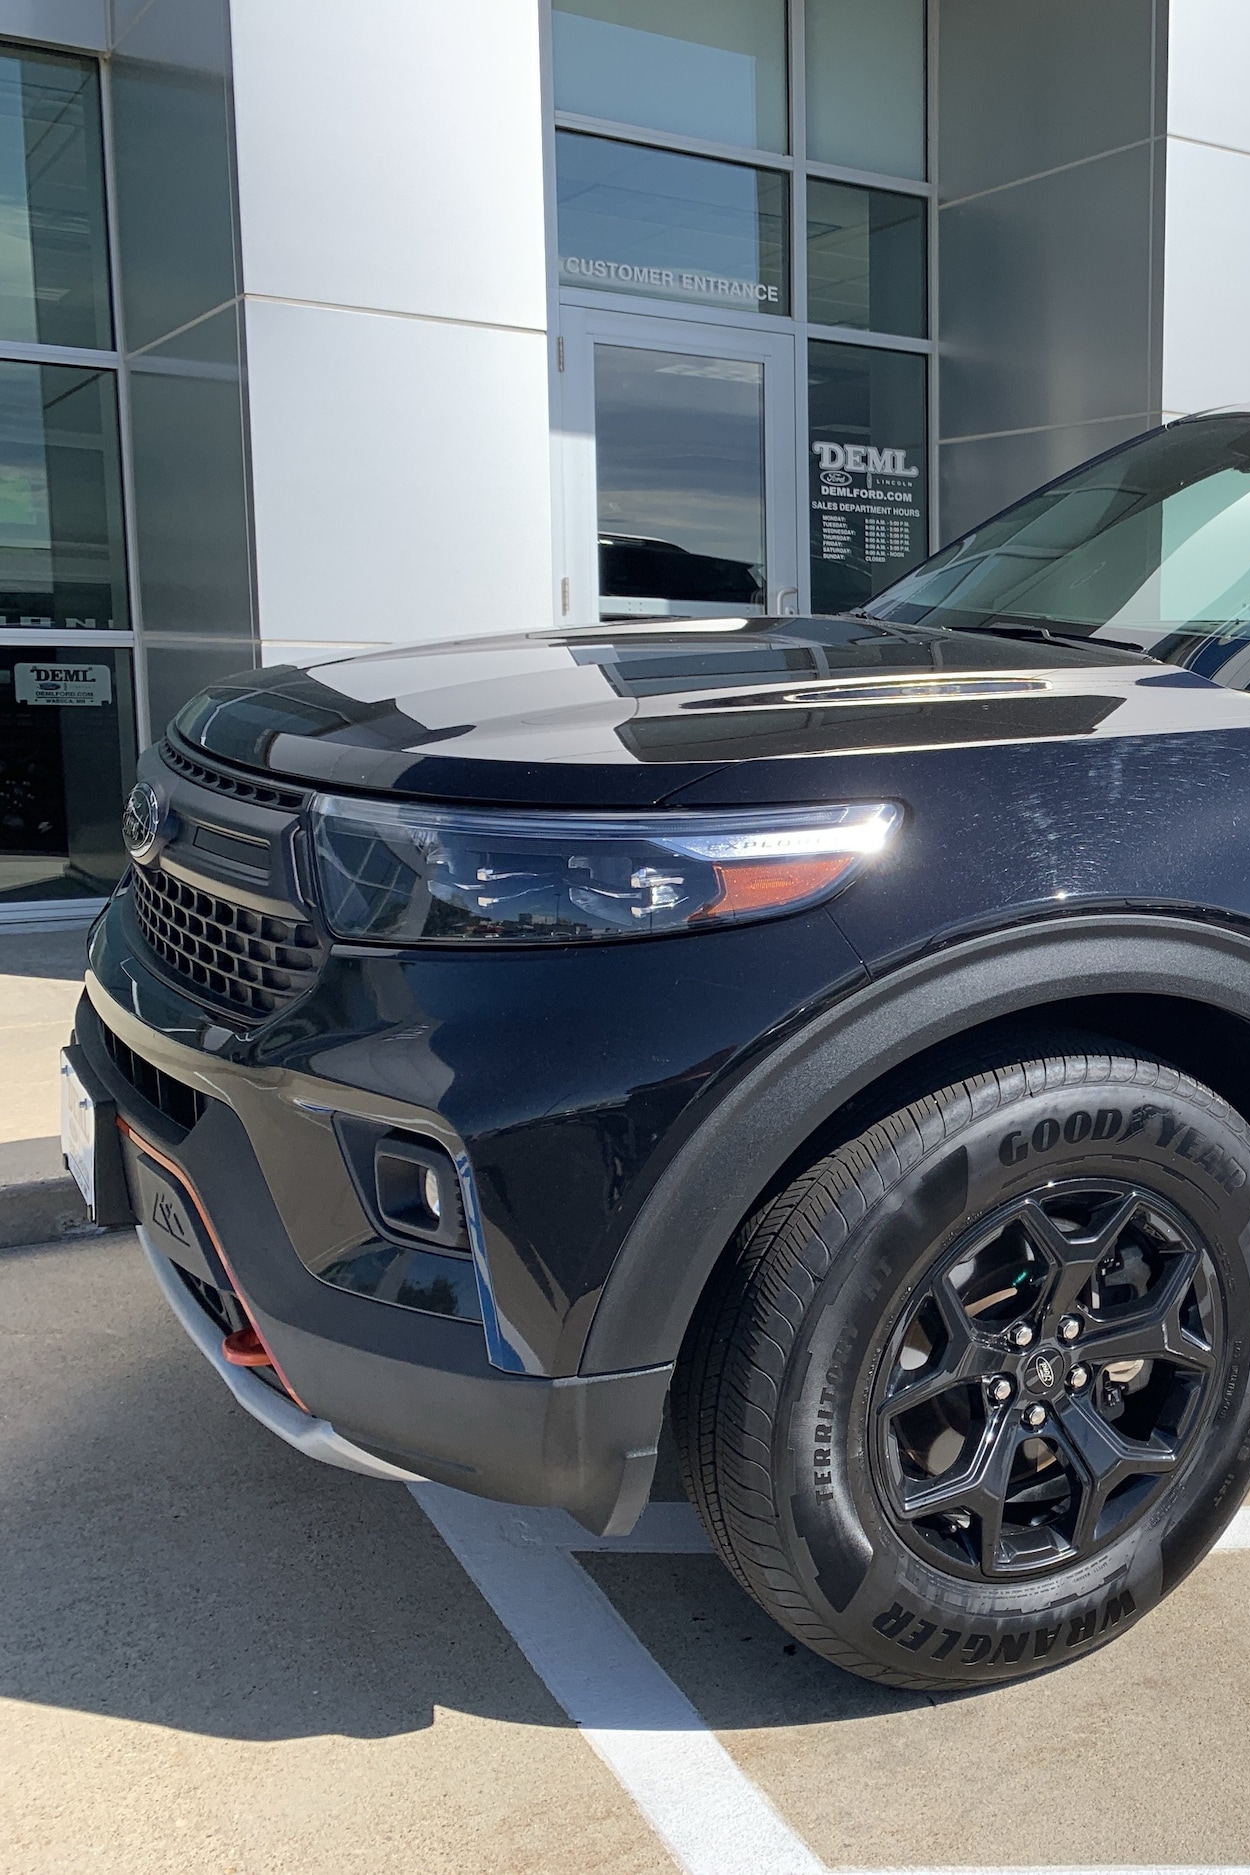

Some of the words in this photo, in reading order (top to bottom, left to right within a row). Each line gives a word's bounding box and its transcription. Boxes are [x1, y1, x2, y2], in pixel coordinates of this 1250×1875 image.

[566, 257, 674, 288] CUSTOMER
[682, 273, 779, 302] ENTRANCE
[812, 441, 920, 478] DEML
[821, 486, 913, 503] DEMLFORD.COM
[876, 479, 913, 488] LINCOLN
[811, 501, 838, 511] SALES
[840, 503, 892, 515] DEPARTMENT
[893, 507, 920, 518] HOURS
[30, 669, 97, 682] DEML
[999, 1104, 1248, 1196] GOODYEAR
[814, 1319, 858, 1505] TERRITORY
[872, 1589, 1137, 1666] WRANGLER
